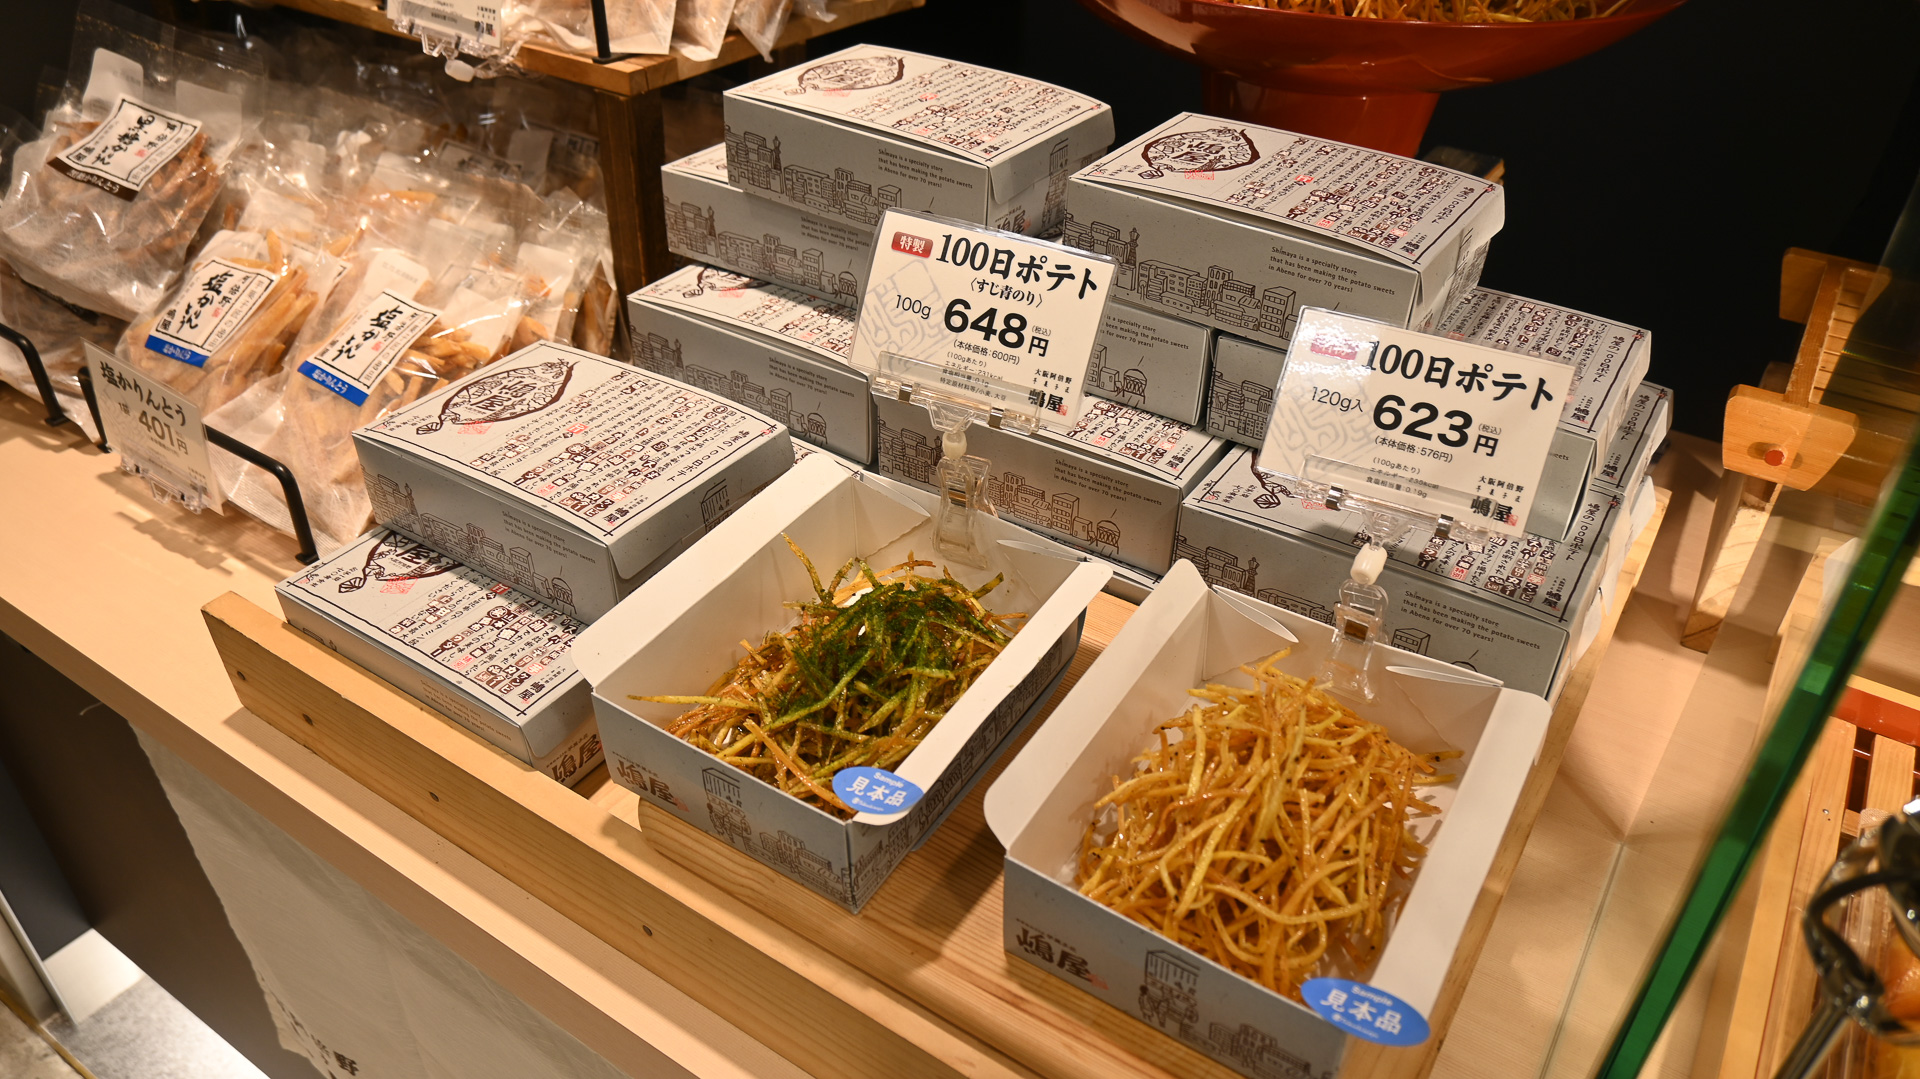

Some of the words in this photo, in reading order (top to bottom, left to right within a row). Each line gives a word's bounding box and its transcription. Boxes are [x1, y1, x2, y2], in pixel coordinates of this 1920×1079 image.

[878, 149, 897, 159] Shimaya
[909, 159, 929, 169] specialty
[884, 167, 898, 176] Abeno
[928, 180, 942, 188] years!
[911, 167, 928, 177] making
[939, 175, 954, 184] potato
[956, 180, 973, 189] sweets
[900, 235, 926, 254] 特製
[936, 234, 1097, 300] 100日ポテト
[1271, 256, 1283, 264] that
[1297, 264, 1311, 272] been
[1314, 269, 1336, 280] making
[1350, 279, 1371, 289] potato
[1374, 285, 1395, 295] sweets
[1272, 246, 1296, 259] Shimaya
[1312, 259, 1339, 271] specialty
[1341, 267, 1357, 275] store
[1276, 266, 1295, 276] Abeno
[1308, 276, 1322, 284] over
[1334, 284, 1353, 292] years!
[896, 294, 931, 320] 100g
[945, 298, 1027, 348] 648
[1106, 322, 1118, 330] been
[1120, 327, 1139, 337] making
[1151, 335, 1169, 344] potato
[1171, 341, 1189, 349] sweets
[1118, 318, 1141, 329] specialty
[1142, 325, 1156, 333] store
[1138, 340, 1154, 348] years!
[1034, 368, 1072, 385] 大阪阿倍野
[1362, 341, 1553, 410] 100日ポテト
[100, 361, 186, 427] 塩かりんとう
[1028, 389, 1064, 413] 嶋屋
[138, 410, 175, 447] 401
[1311, 386, 1364, 413] 120g入
[1373, 394, 1473, 448] 623
[1055, 459, 1077, 471] Shimaya
[1090, 471, 1113, 482] specialty
[1115, 478, 1129, 488] store
[1055, 466, 1066, 474] that
[1078, 473, 1091, 482] been
[1092, 478, 1111, 490] making
[1124, 489, 1141, 499] potato
[1143, 496, 1162, 505] sweets
[1061, 476, 1077, 485] Abeno
[1110, 493, 1126, 501] years!
[1479, 475, 1525, 493] 大阪阿倍野
[1470, 495, 1514, 523] 嶋屋
[1403, 599, 1417, 608] that
[1420, 604, 1430, 613] has
[1433, 608, 1448, 618] been
[1451, 615, 1475, 628] making
[1478, 623, 1488, 632] the
[1491, 629, 1514, 641] potato
[1516, 637, 1540, 649] sweets
[1405, 591, 1432, 604] Shimaya
[1449, 606, 1480, 620] specialty
[1482, 616, 1499, 627] store
[1409, 610, 1430, 621] Abeno
[1445, 622, 1459, 631] over
[1473, 632, 1494, 642] years!
[551, 734, 602, 783] 嶋屋
[616, 759, 678, 806] 嶋屋
[845, 775, 907, 807] 見本品
[873, 772, 904, 788] Sample
[1015, 926, 1092, 983] 嶋屋
[1351, 985, 1393, 1007] Sample
[1320, 988, 1402, 1035] 見本品
